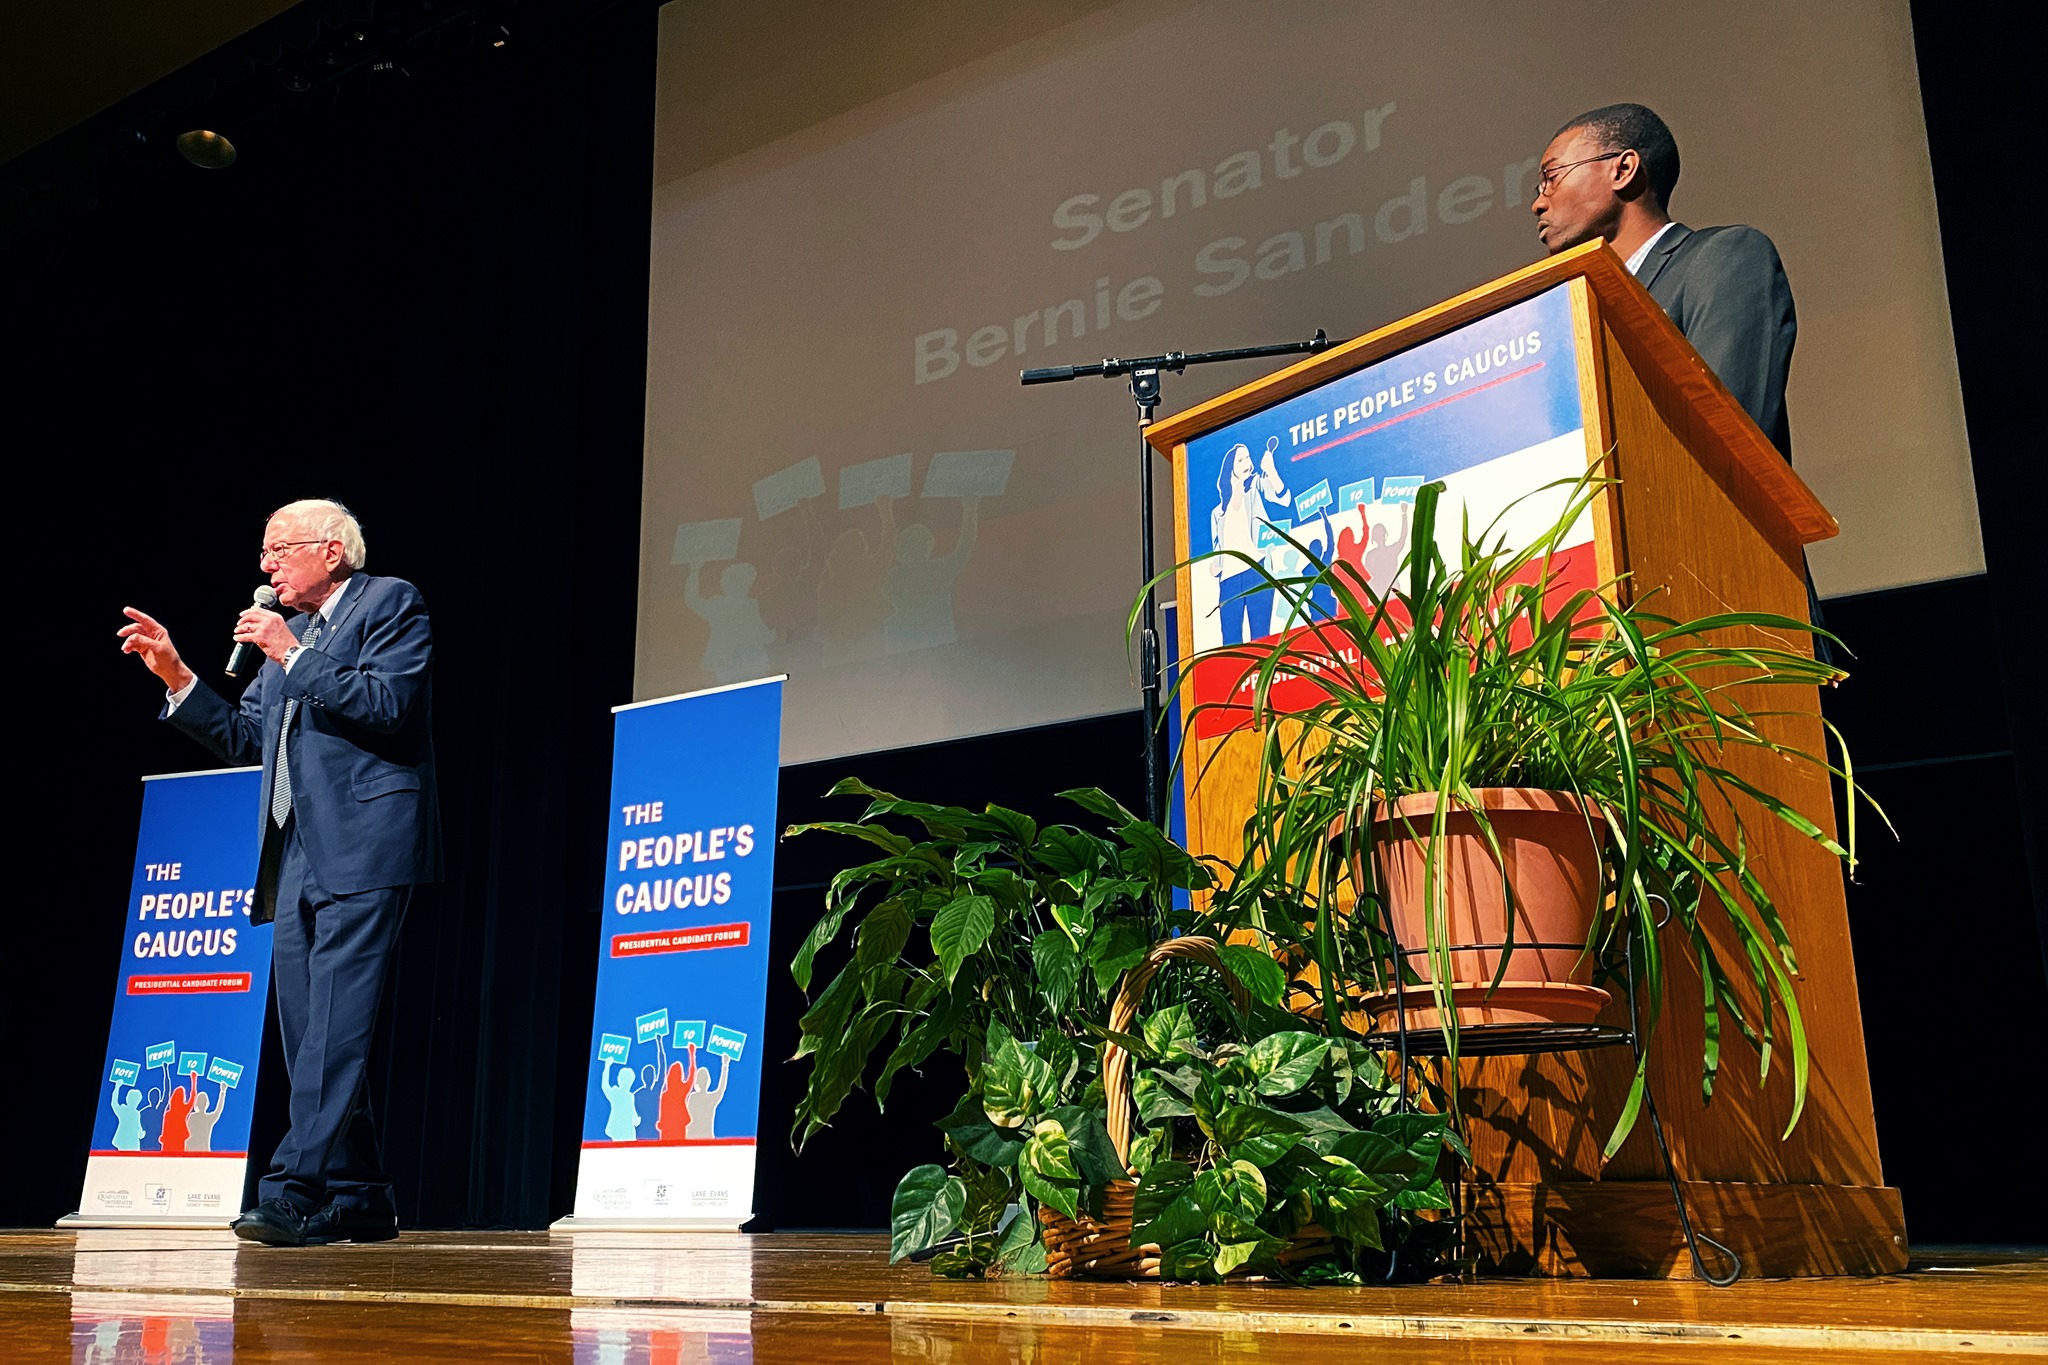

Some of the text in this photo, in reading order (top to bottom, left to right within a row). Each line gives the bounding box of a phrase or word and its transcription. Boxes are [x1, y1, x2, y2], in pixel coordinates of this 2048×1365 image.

[1050, 101, 1397, 252] Senator
[914, 156, 1539, 385] Bernie Sander
[1289, 331, 1542, 447] THE PEOPLE’S CAUCUS
[1299, 487, 1328, 512] TRUTH
[1350, 489, 1364, 501] TO
[1261, 527, 1286, 542] VOT
[622, 801, 664, 826] THE
[619, 824, 755, 872] PEOPLE’S
[145, 863, 182, 881] THE
[616, 872, 732, 915] CAUCUS
[139, 888, 255, 920] PEOPLE’S
[134, 928, 238, 958] CAUCUS
[619, 930, 741, 950] PRESIDENTIAL CANDIDATE FORUM
[134, 978, 243, 989] PRESIDENTIAL CANDIDATE FORUM
[639, 1018, 666, 1034] TRUTH
[683, 1030, 696, 1041] TO
[711, 1034, 742, 1052] POWER
[148, 1048, 173, 1062] TRUTH
[603, 1043, 626, 1055] VOTE
[114, 1067, 135, 1079] VOTE
[187, 1060, 198, 1069] TO
[211, 1065, 239, 1081] POWER
[692, 1190, 729, 1198] LANE EVANS
